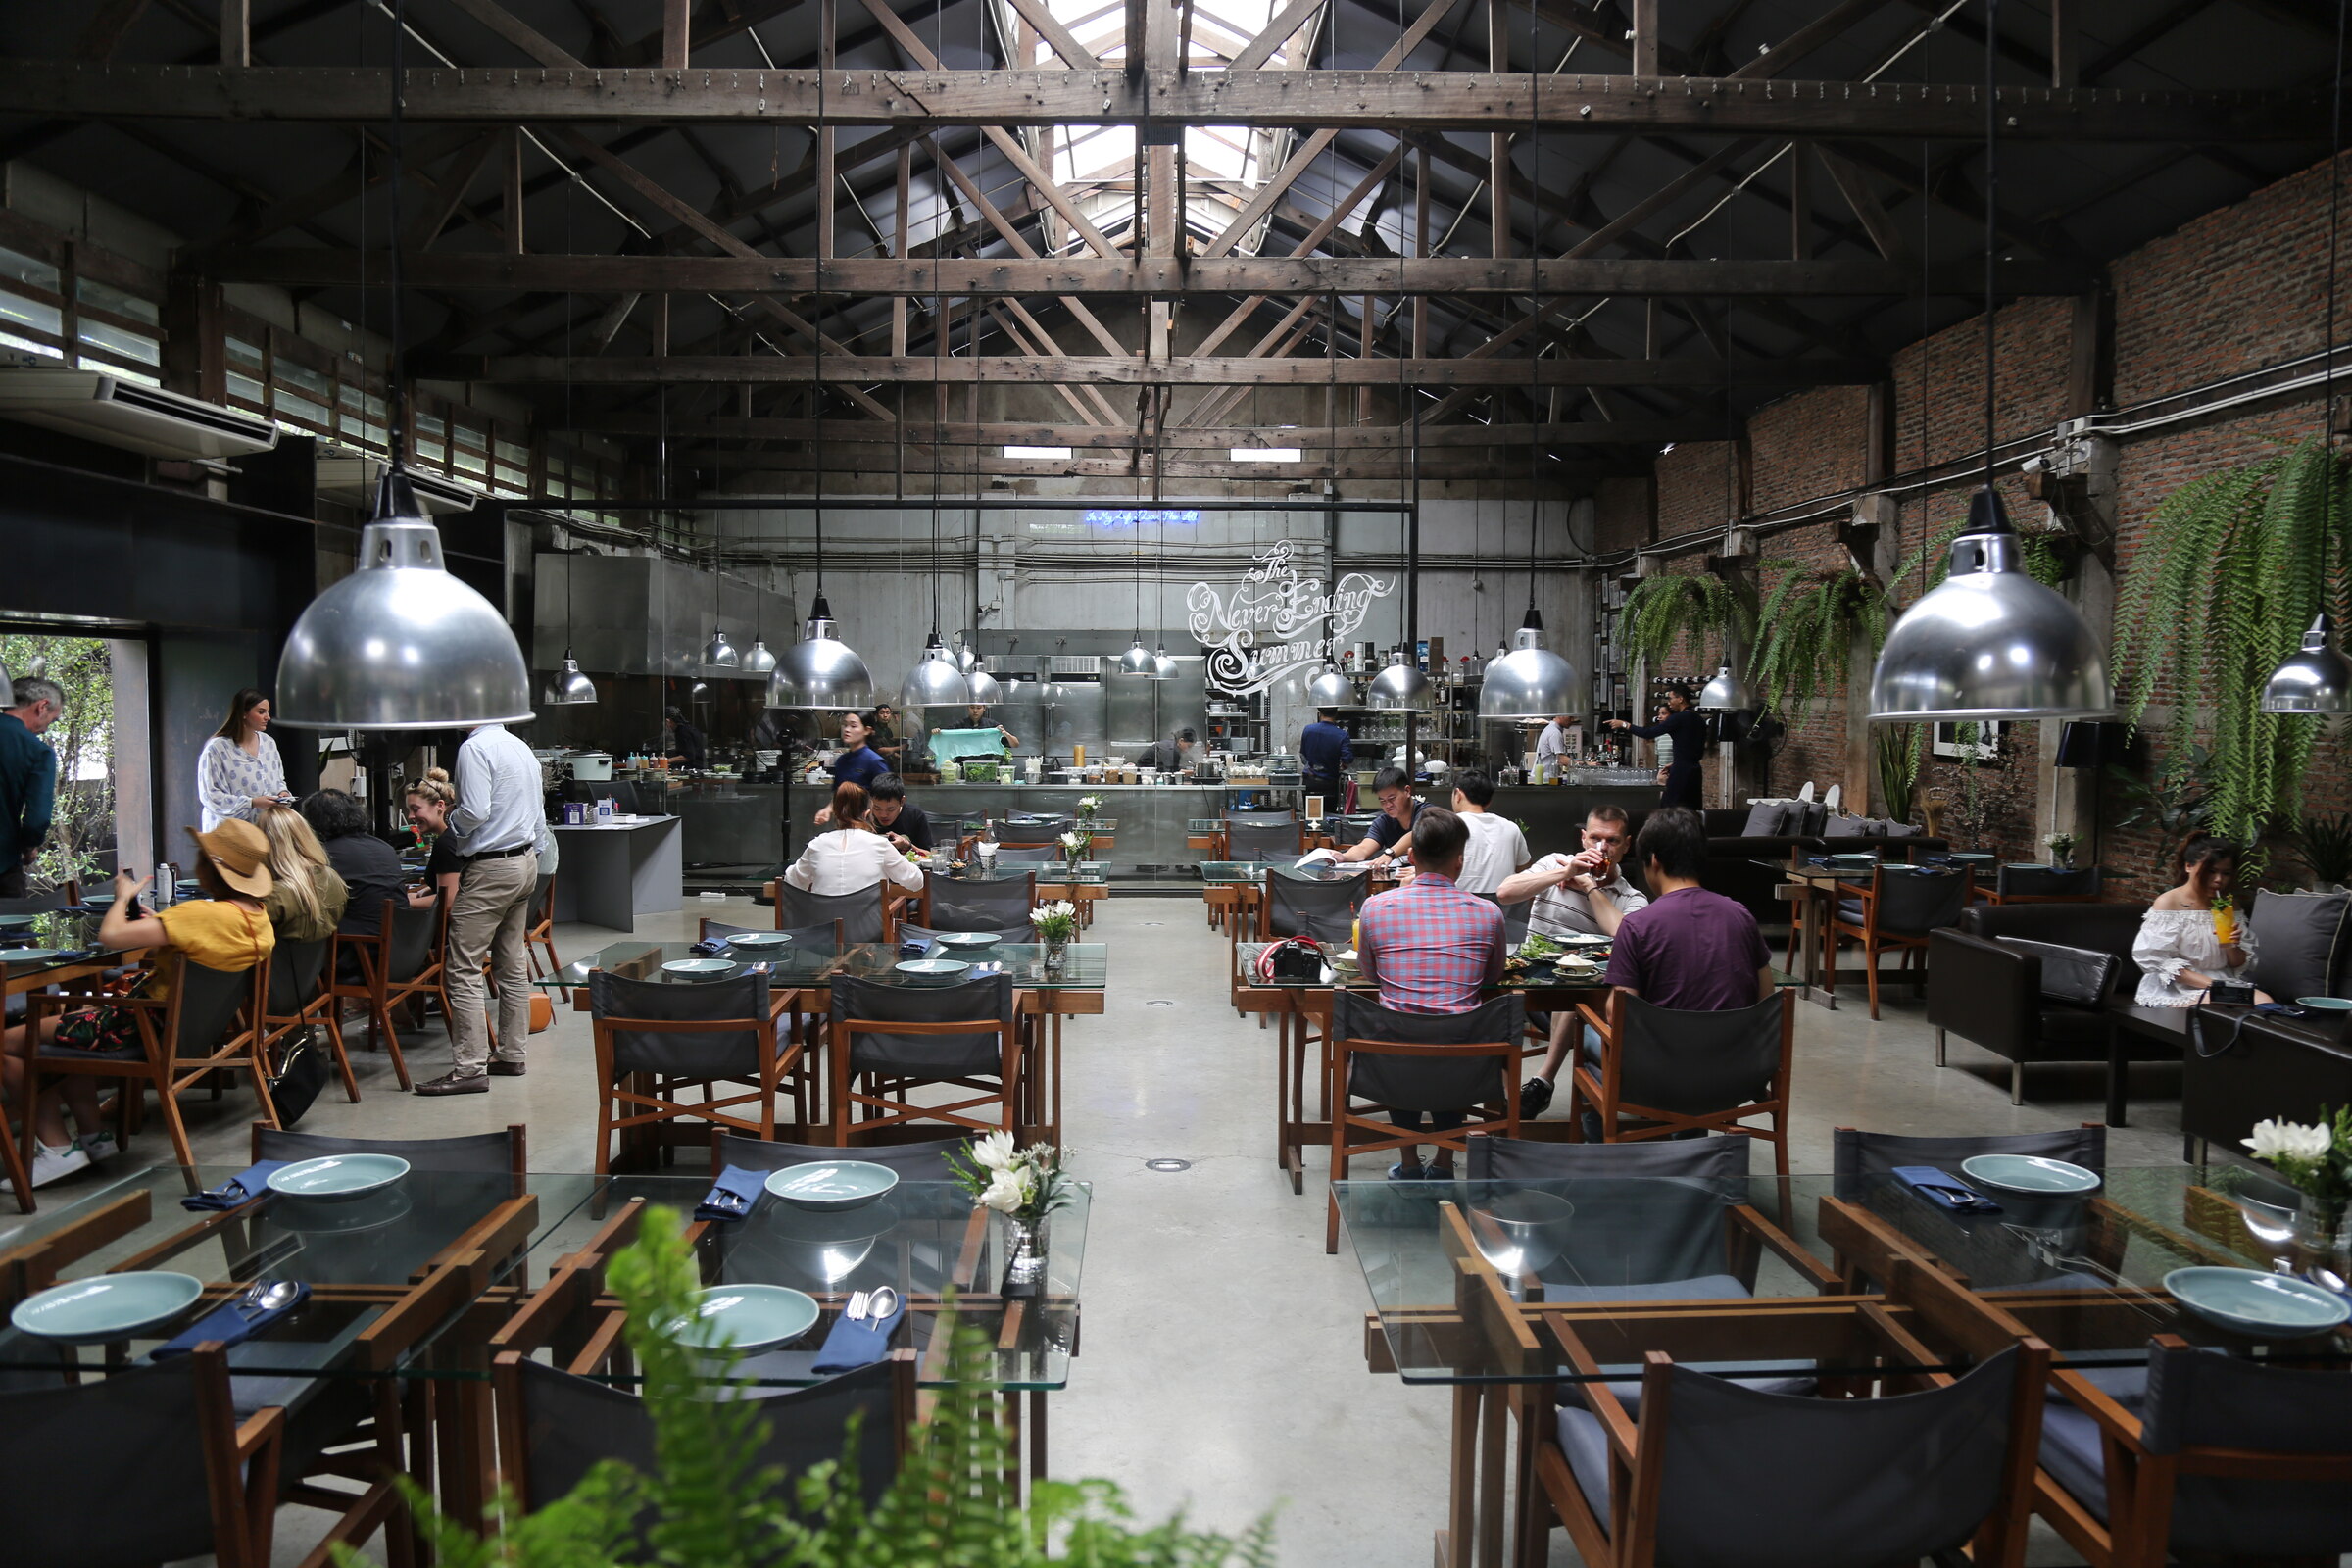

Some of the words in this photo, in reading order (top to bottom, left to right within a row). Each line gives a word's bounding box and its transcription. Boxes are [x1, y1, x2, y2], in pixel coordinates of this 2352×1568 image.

[1098, 511, 1114, 526] My
[1249, 540, 1295, 584] The
[1187, 582, 1284, 633] Never
[1274, 570, 1396, 639] Ending
[1208, 629, 1342, 681] Summer
